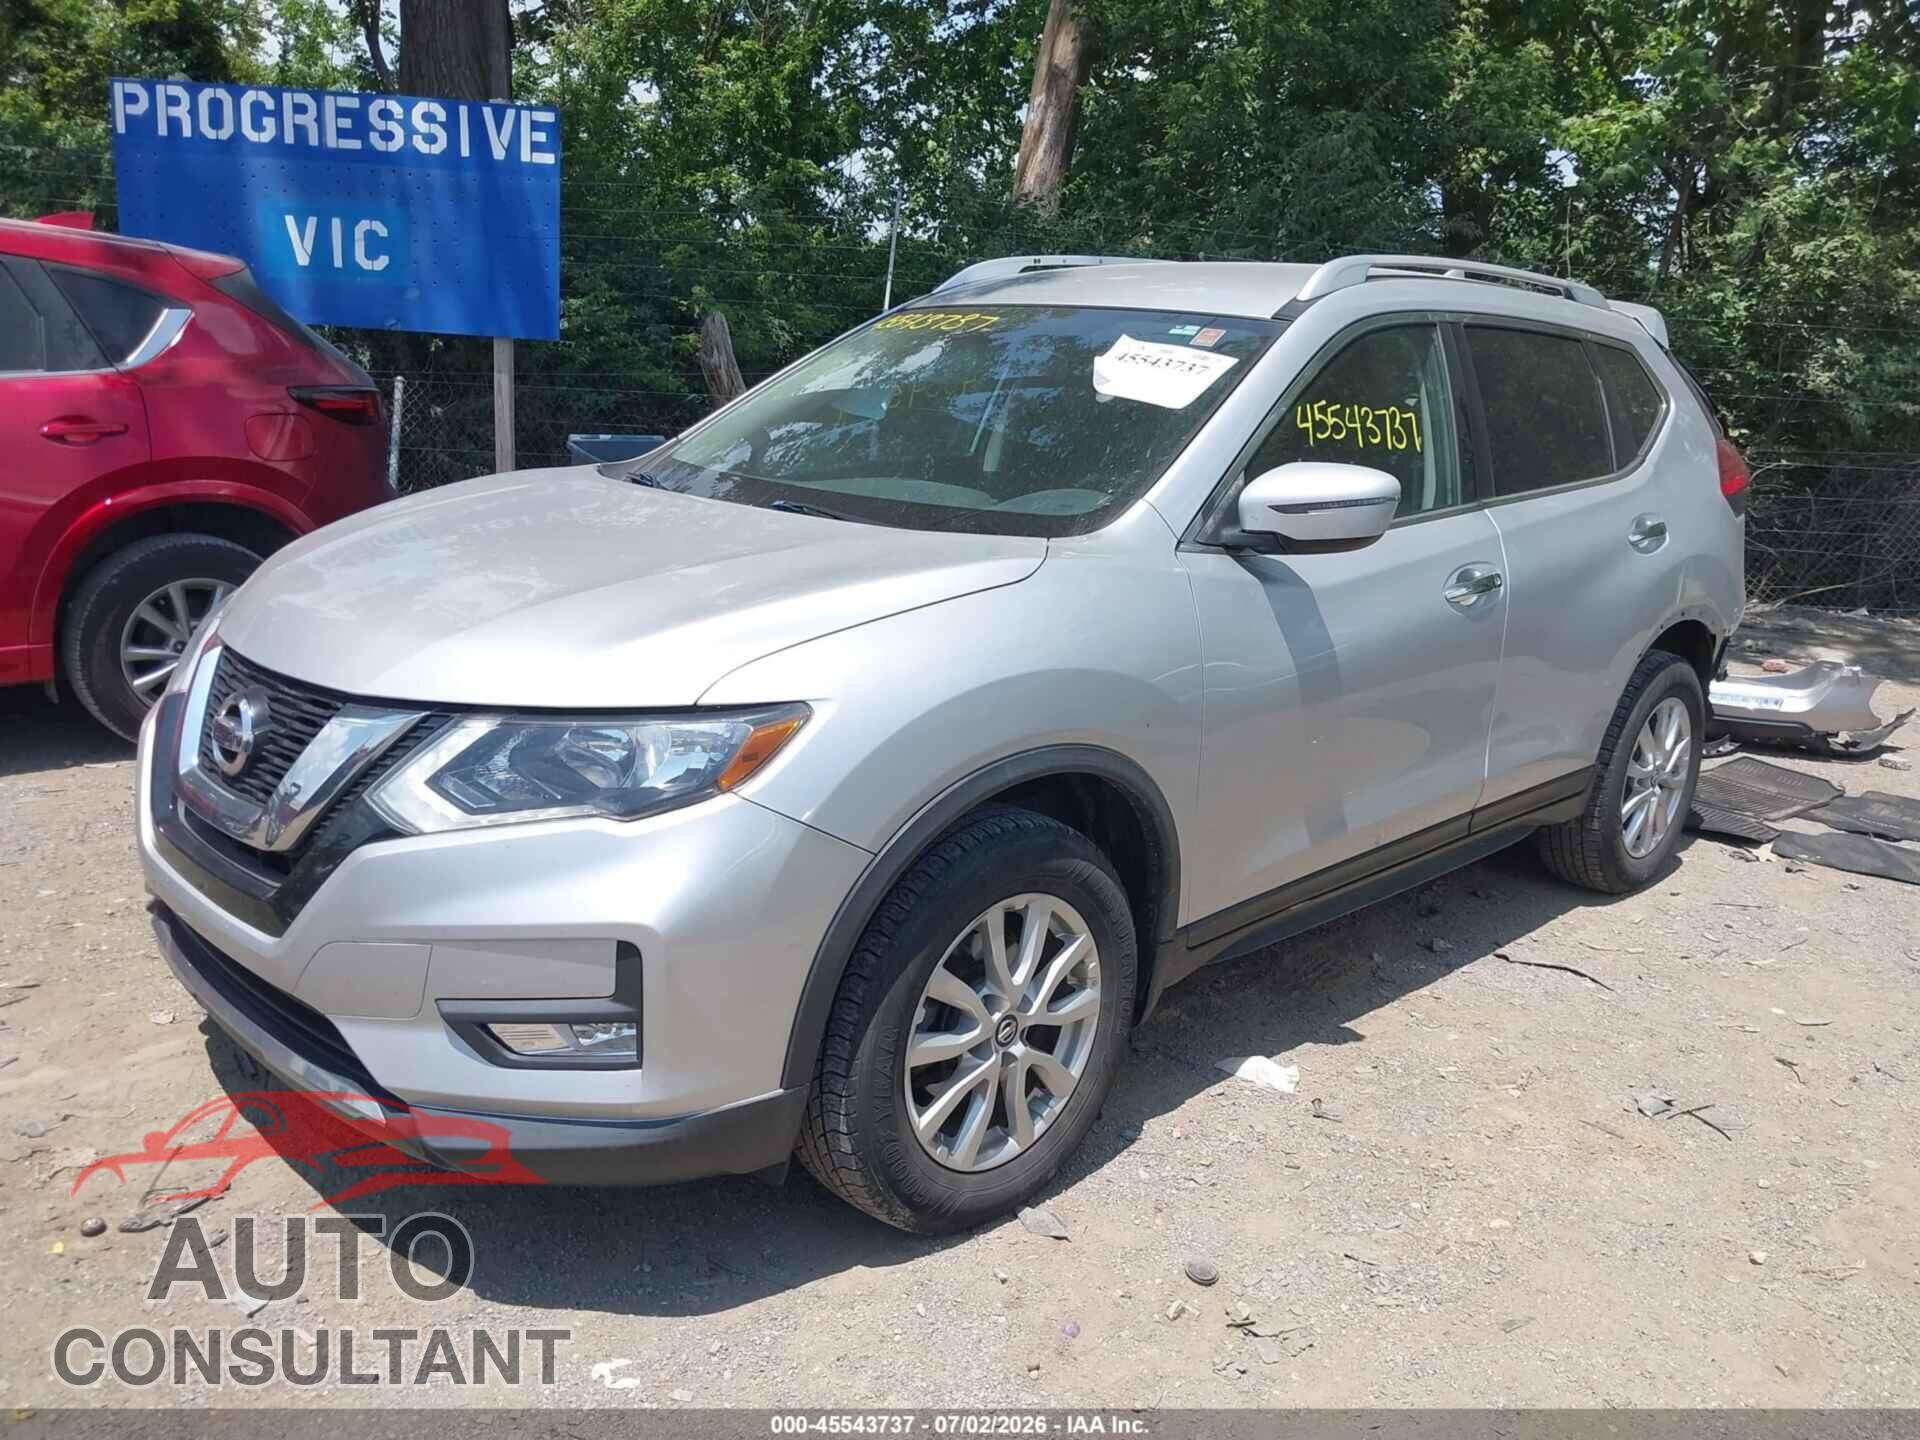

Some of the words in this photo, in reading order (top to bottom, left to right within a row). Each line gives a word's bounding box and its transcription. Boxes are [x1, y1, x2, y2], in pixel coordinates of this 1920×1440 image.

[113, 82, 556, 165] PROGRESSIVE
[284, 215, 390, 271] VIC
[1296, 399, 1422, 453] 45543737
